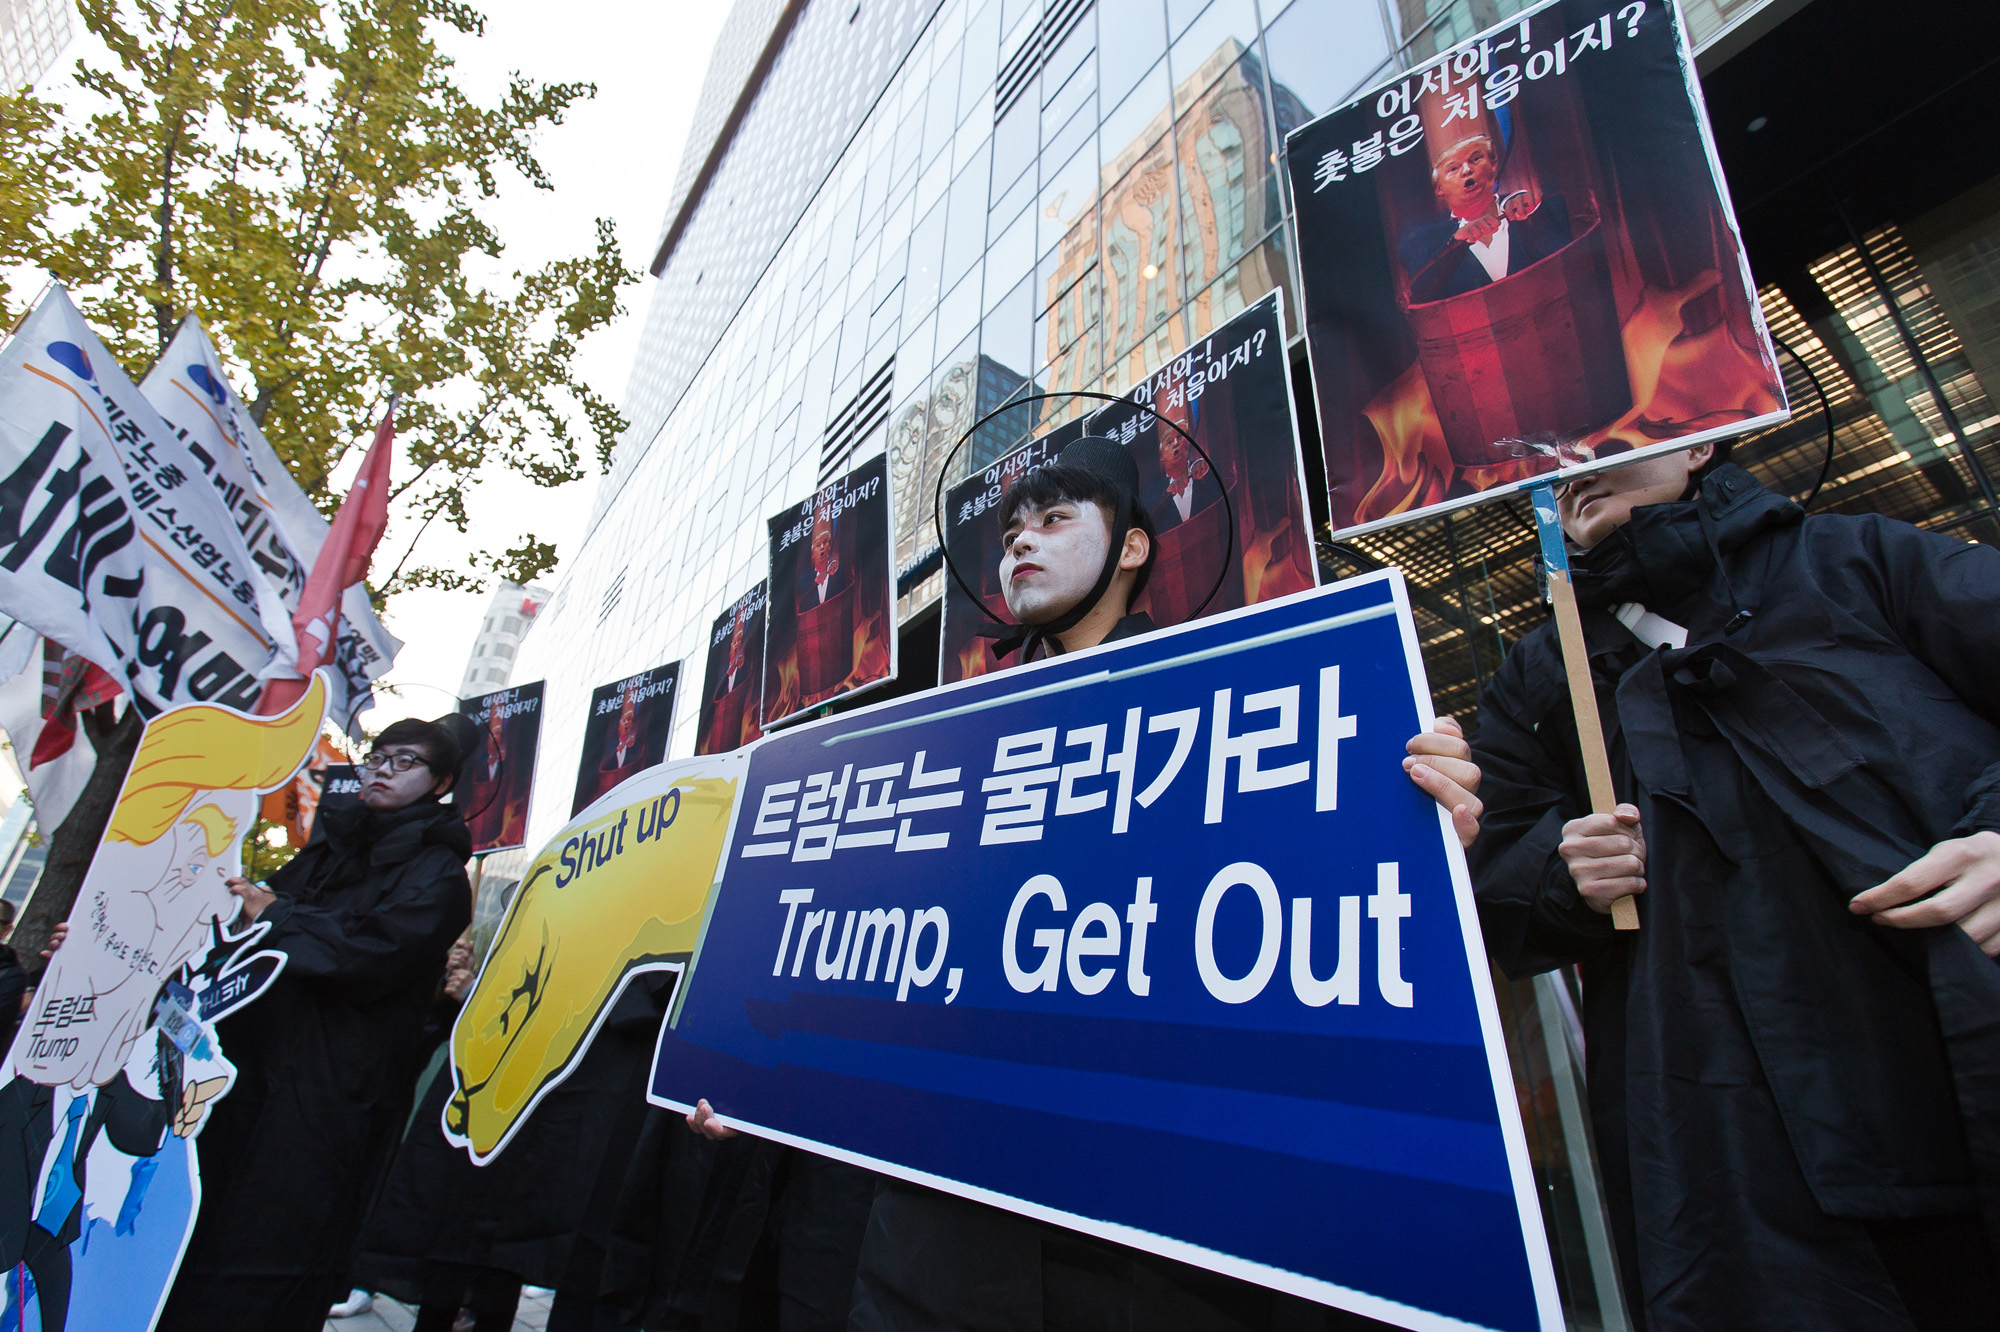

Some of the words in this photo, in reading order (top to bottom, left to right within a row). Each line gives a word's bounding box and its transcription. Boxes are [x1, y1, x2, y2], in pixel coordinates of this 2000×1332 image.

[1313, 114, 1423, 193] 촛불은
[1441, 1, 1646, 127] 처음이지?
[1376, 18, 1532, 118] 어서와~!
[1134, 338, 1212, 404] 어서와~!
[1165, 328, 1267, 413] 처음이지?
[985, 439, 1047, 484] 어서와~!
[779, 516, 814, 552] 촛불은
[817, 476, 879, 524] 처음이지?
[801, 476, 849, 515] 어서와~!
[958, 484, 1001, 526] 촛불은
[494, 697, 539, 720] 처음이지?
[627, 677, 673, 704] 처음이지?
[741, 751, 964, 862] 트럼프는
[980, 665, 1356, 845] 물러가라
[555, 817, 624, 889] Shut
[636, 785, 680, 843] up
[773, 889, 963, 1004] Trump,
[1003, 875, 1157, 996] Get
[1195, 862, 1413, 1007] Out
[35, 994, 98, 1028] 트럼프
[26, 1033, 79, 1061] Trump
